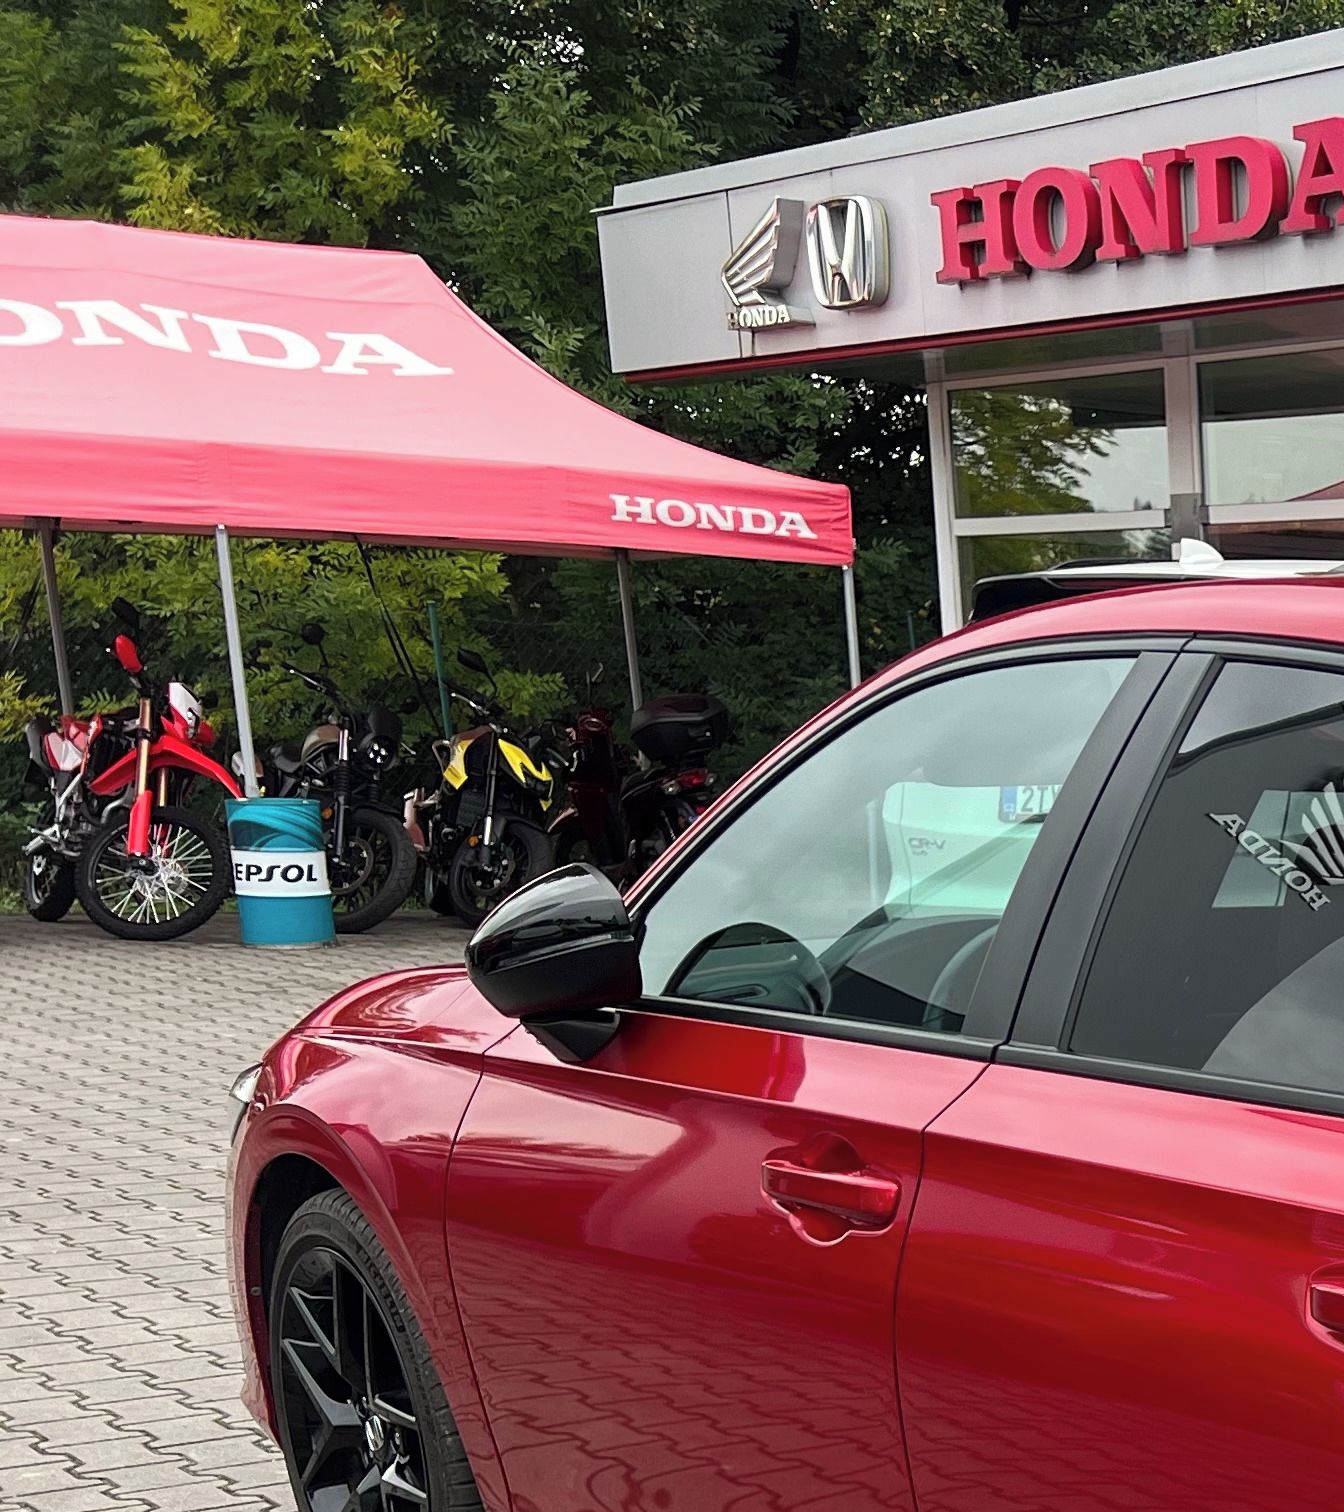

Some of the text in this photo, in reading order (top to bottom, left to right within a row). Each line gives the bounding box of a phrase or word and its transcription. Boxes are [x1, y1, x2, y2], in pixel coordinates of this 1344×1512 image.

[727, 304, 791, 328] HONDA
[0, 299, 455, 376] ONDA
[609, 494, 818, 539] HONDA
[234, 863, 318, 883] EPSOL
